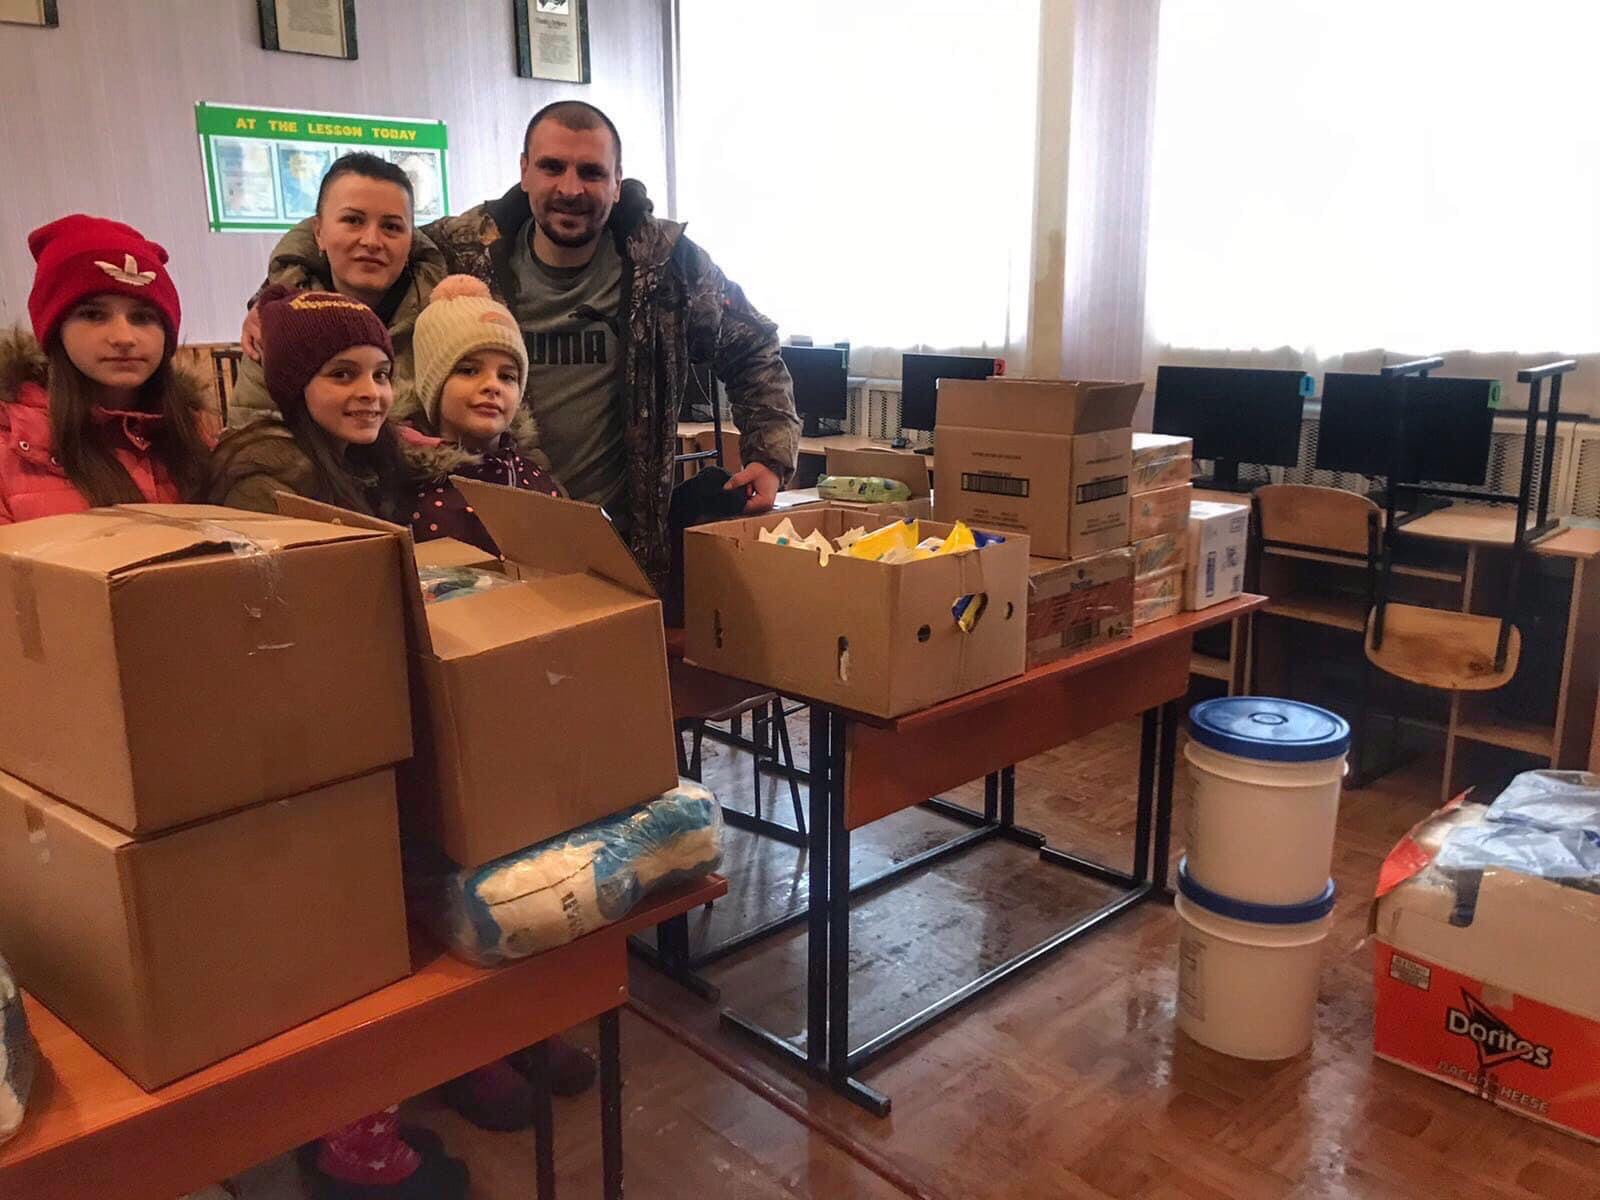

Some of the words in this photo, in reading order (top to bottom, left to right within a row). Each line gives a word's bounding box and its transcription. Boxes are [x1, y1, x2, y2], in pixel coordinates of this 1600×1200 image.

[236, 117, 256, 129] AT
[268, 119, 298, 133] THE
[307, 122, 362, 137] LESSON
[371, 127, 416, 141] TODAY
[524, 330, 607, 365] UMA
[1449, 1008, 1550, 1068] Doritos
